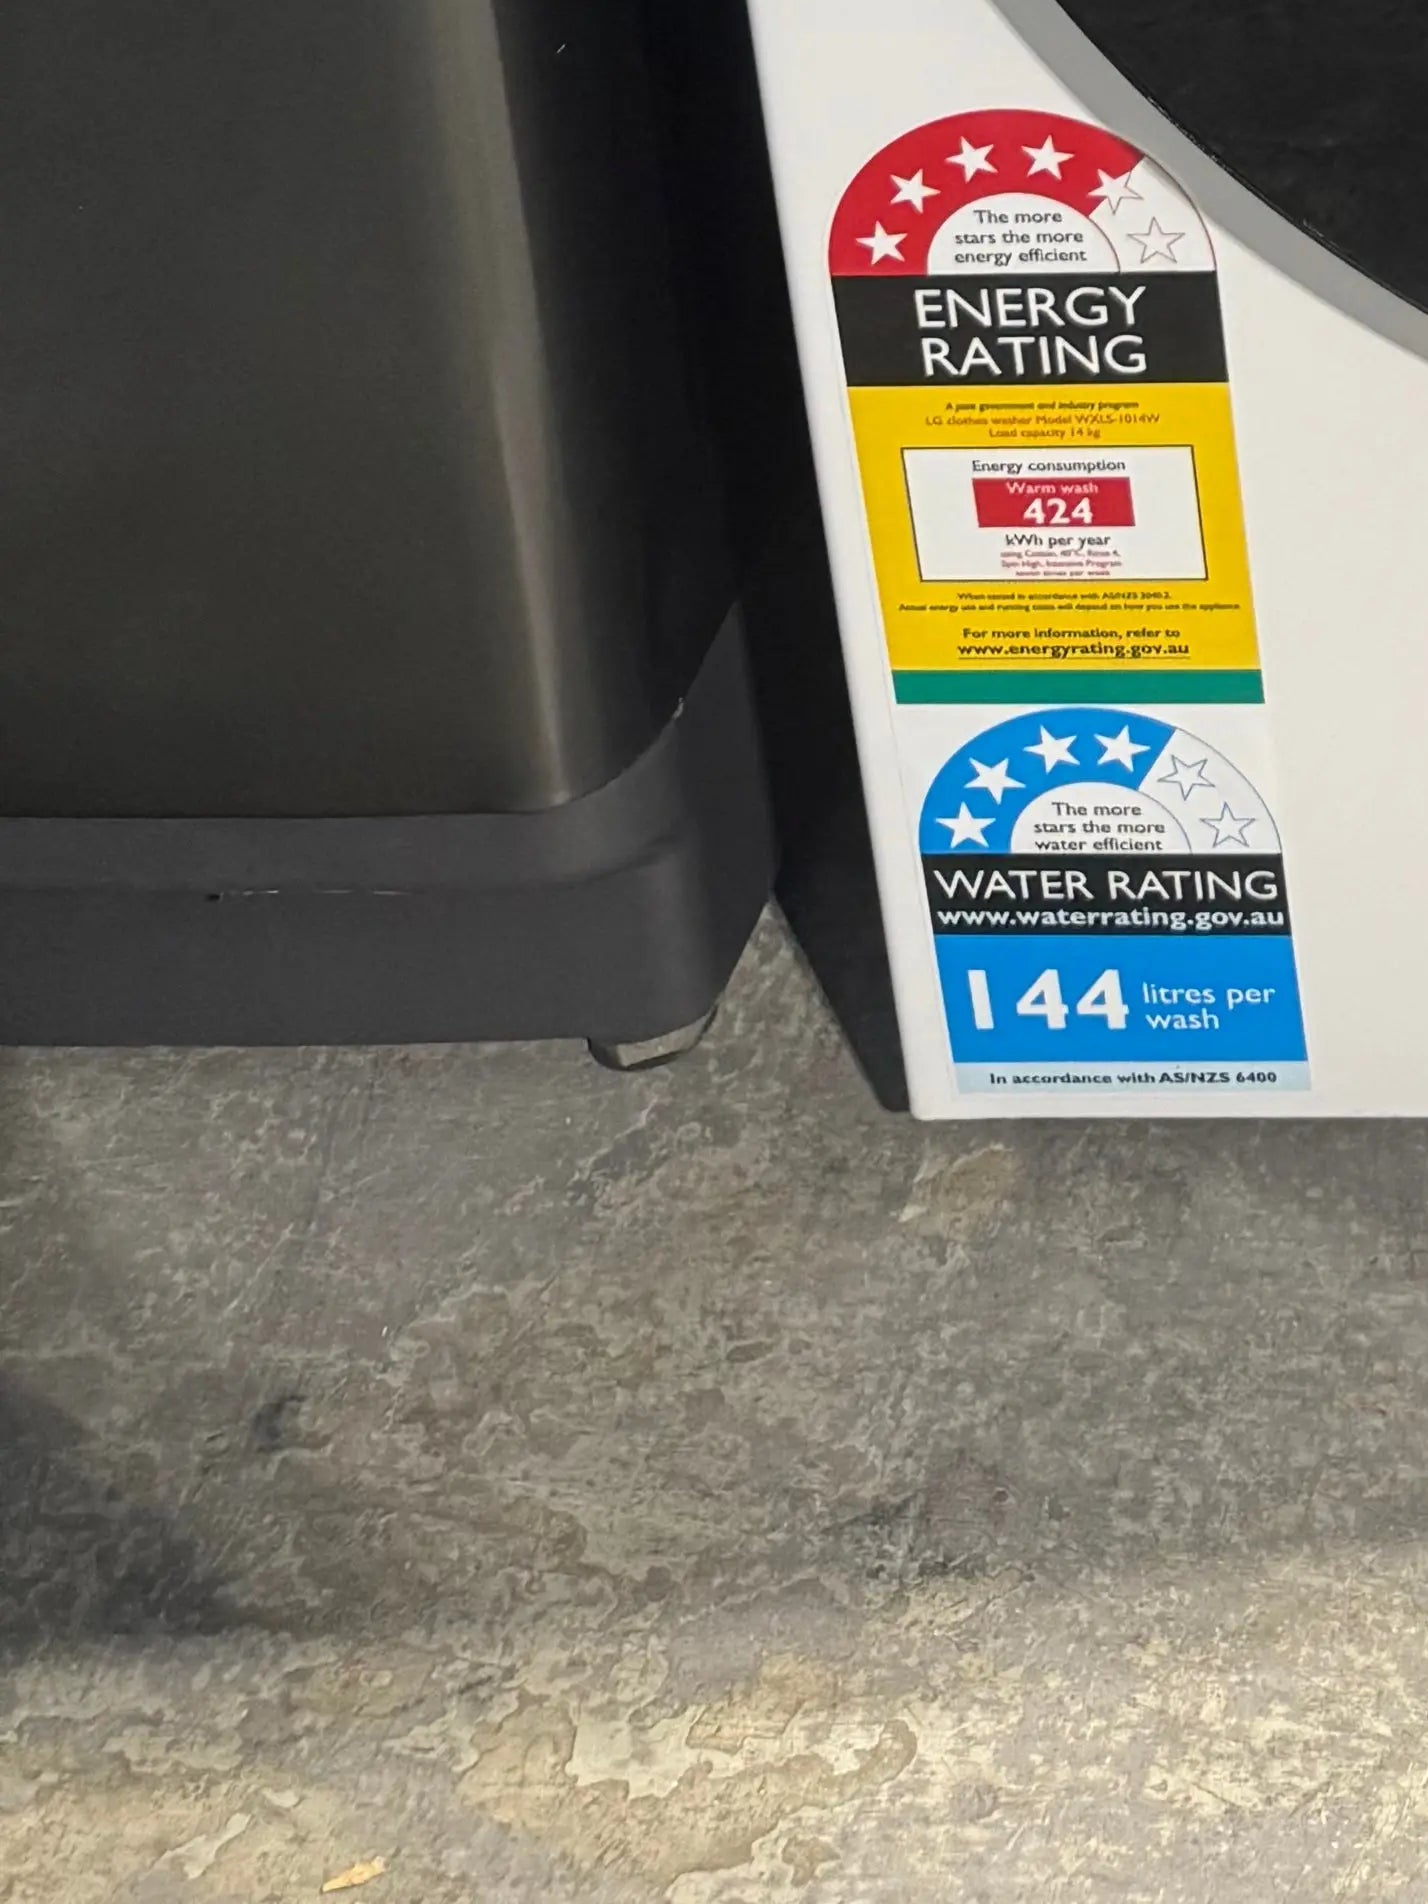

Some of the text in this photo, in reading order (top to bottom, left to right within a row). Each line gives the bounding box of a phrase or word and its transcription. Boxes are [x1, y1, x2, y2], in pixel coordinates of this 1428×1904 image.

[973, 209, 1063, 225] The more
[954, 228, 1084, 245] stars the more
[954, 247, 1087, 267] energy efficient
[914, 286, 1147, 330] ENERGY
[920, 336, 1148, 377] RATING
[925, 415, 943, 425] LG
[1035, 413, 1073, 424] Model
[1071, 427, 1083, 437] 14
[972, 460, 1126, 475] Energy consumption
[1006, 482, 1099, 494] Warm wash
[1023, 497, 1093, 524] 424
[1006, 534, 1111, 551] kWh per year
[963, 627, 1180, 641] For more information, refer to
[958, 642, 1189, 658] www.energyrating.gov.au
[1051, 801, 1142, 816] The more
[1034, 820, 1165, 834] stars the more
[1035, 837, 1163, 851] water efficient
[933, 869, 1278, 901] WATER RATING
[937, 906, 1284, 932] www.waterrating.gov.au
[967, 968, 1130, 1030] 144
[1142, 982, 1275, 1010] litres per
[1146, 1008, 1220, 1030] wash
[990, 1071, 1277, 1084] In accordance with AS/NZS 6400
